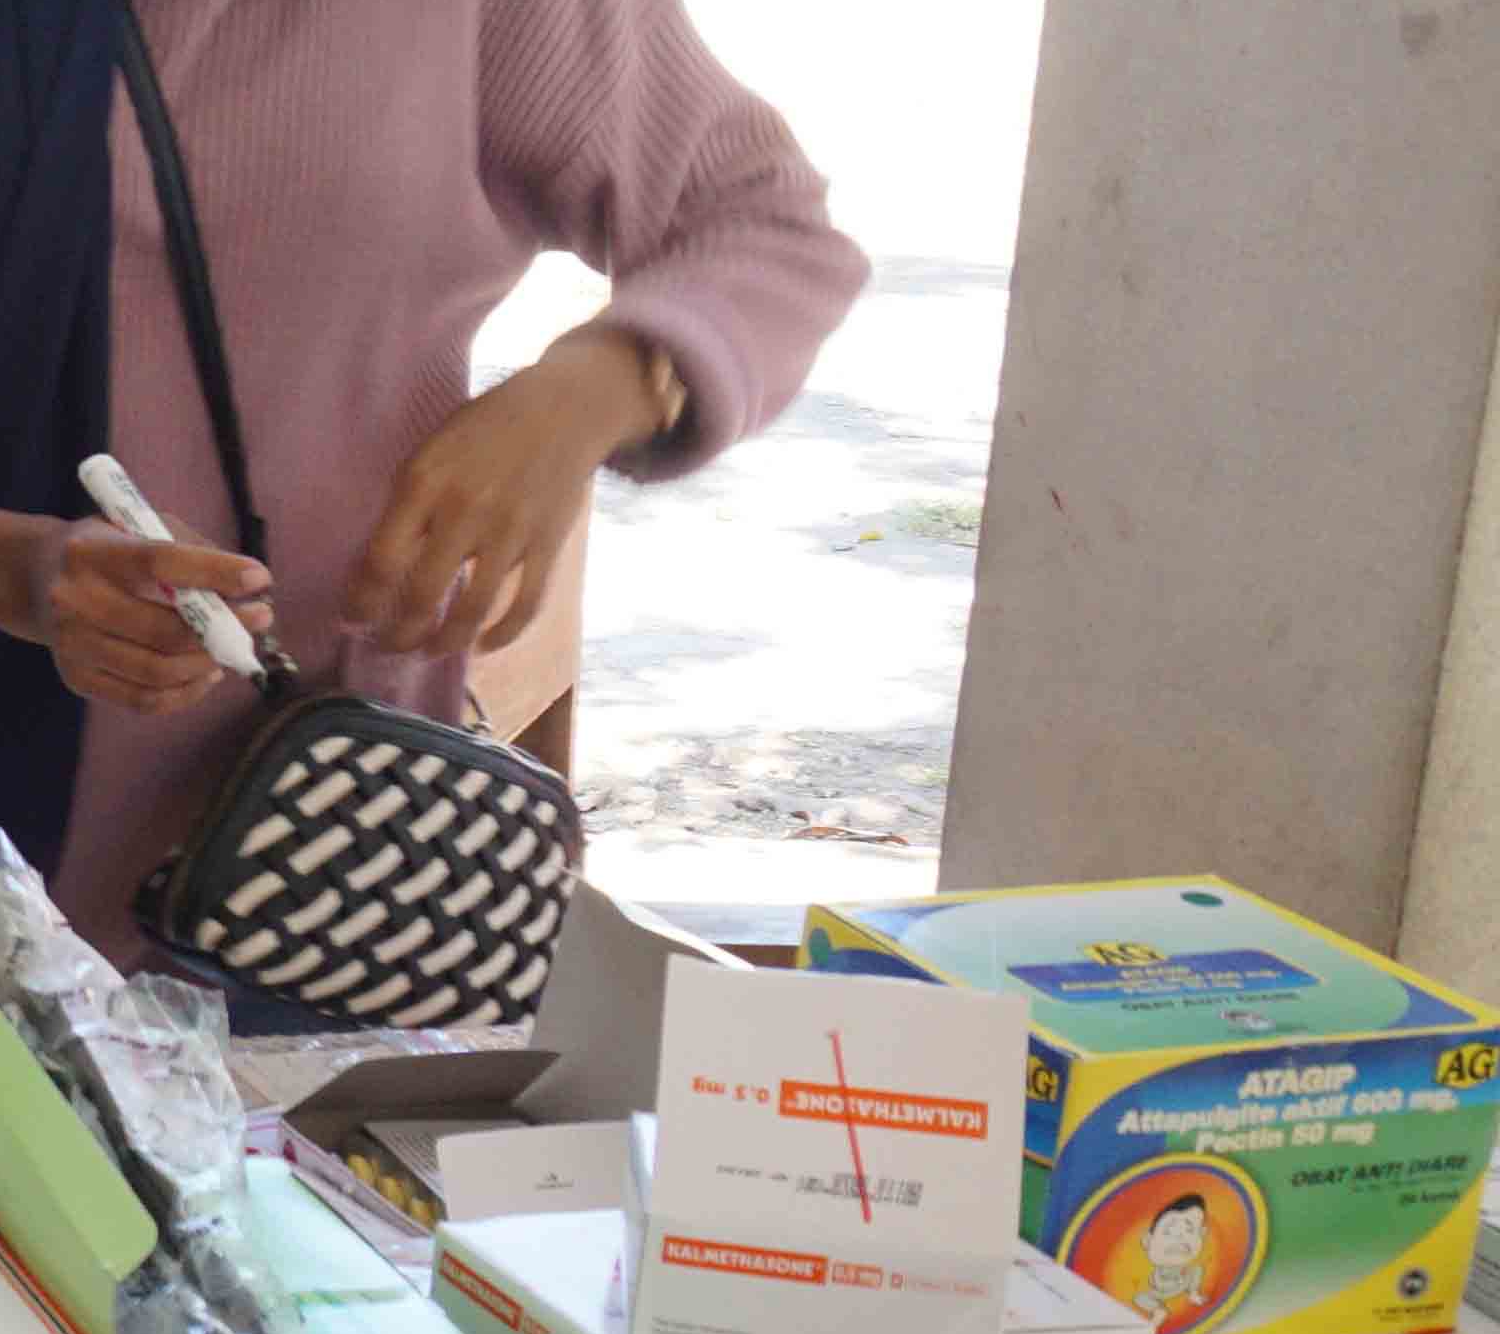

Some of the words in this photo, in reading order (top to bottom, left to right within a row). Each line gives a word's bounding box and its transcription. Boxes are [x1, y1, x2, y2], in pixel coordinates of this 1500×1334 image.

[1239, 1064, 1357, 1100] ATAGIP
[1442, 1048, 1494, 1084] AG
[692, 1077, 728, 1098] mg
[1117, 1103, 1278, 1135] Attapulgite
[1283, 1095, 1349, 1120] aktif
[1355, 1091, 1403, 1114] 600
[1196, 1126, 1284, 1153] Pectin
[1331, 1121, 1376, 1146] mg
[1291, 1168, 1347, 1188] OBAT
[1353, 1162, 1403, 1182] ANTI
[1408, 1155, 1468, 1175] DIARE
[665, 1241, 817, 1278] KALMETHASONE
